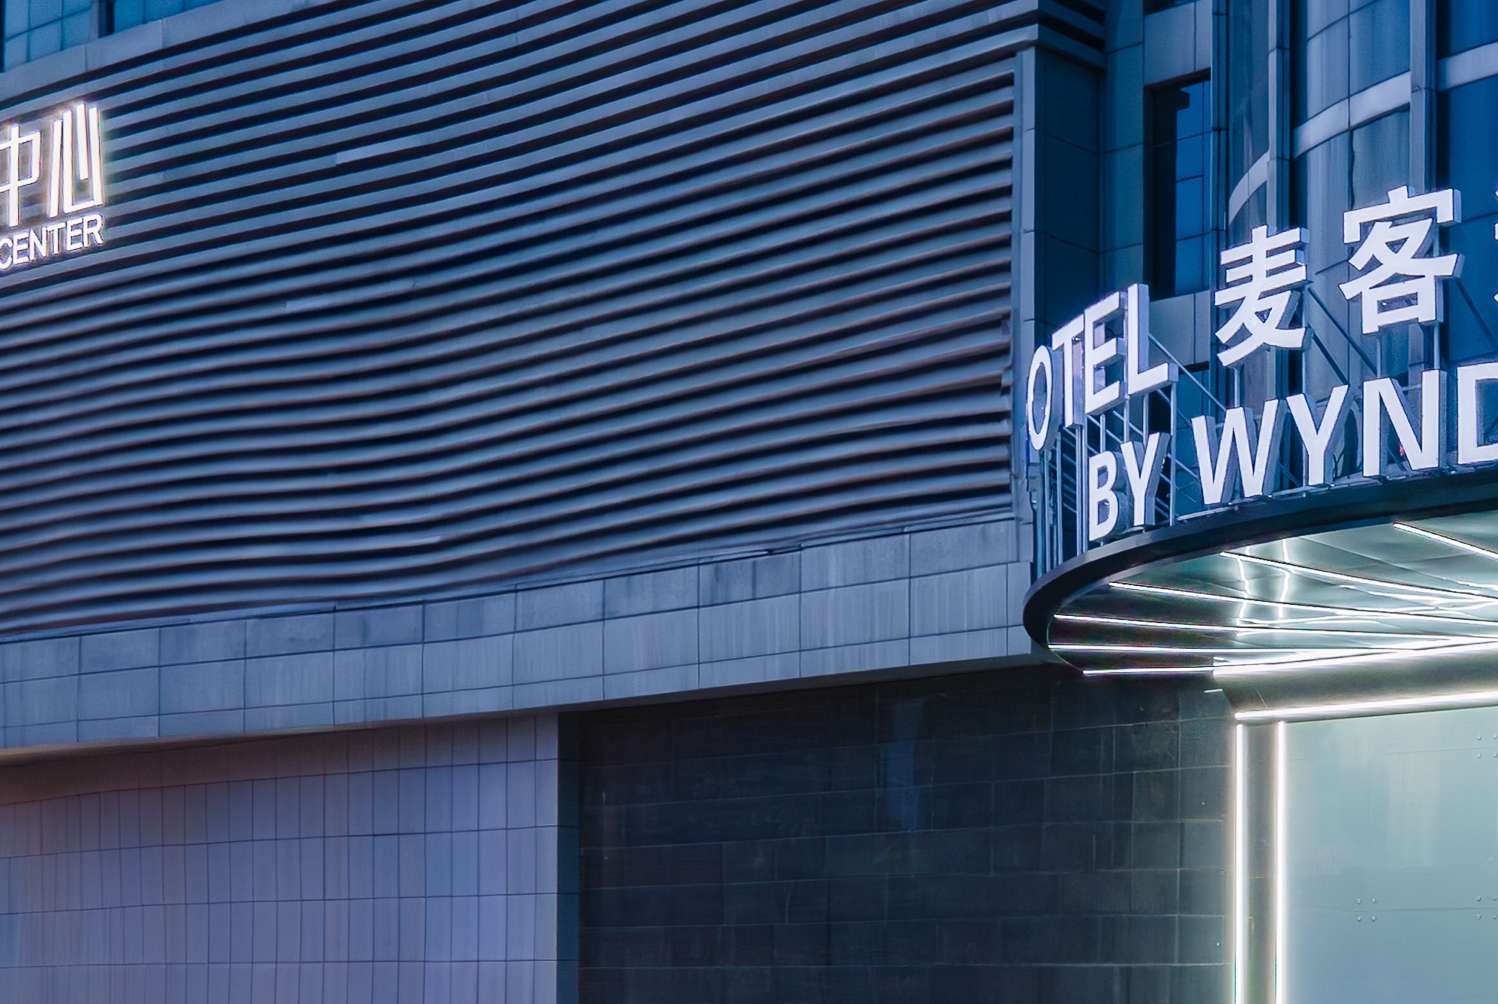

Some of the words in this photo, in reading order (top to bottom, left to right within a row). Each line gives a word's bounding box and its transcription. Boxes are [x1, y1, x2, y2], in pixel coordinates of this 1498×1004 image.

[0, 103, 103, 227] 中心
[0, 213, 103, 270] CENTER
[1088, 432, 1171, 542] BY
